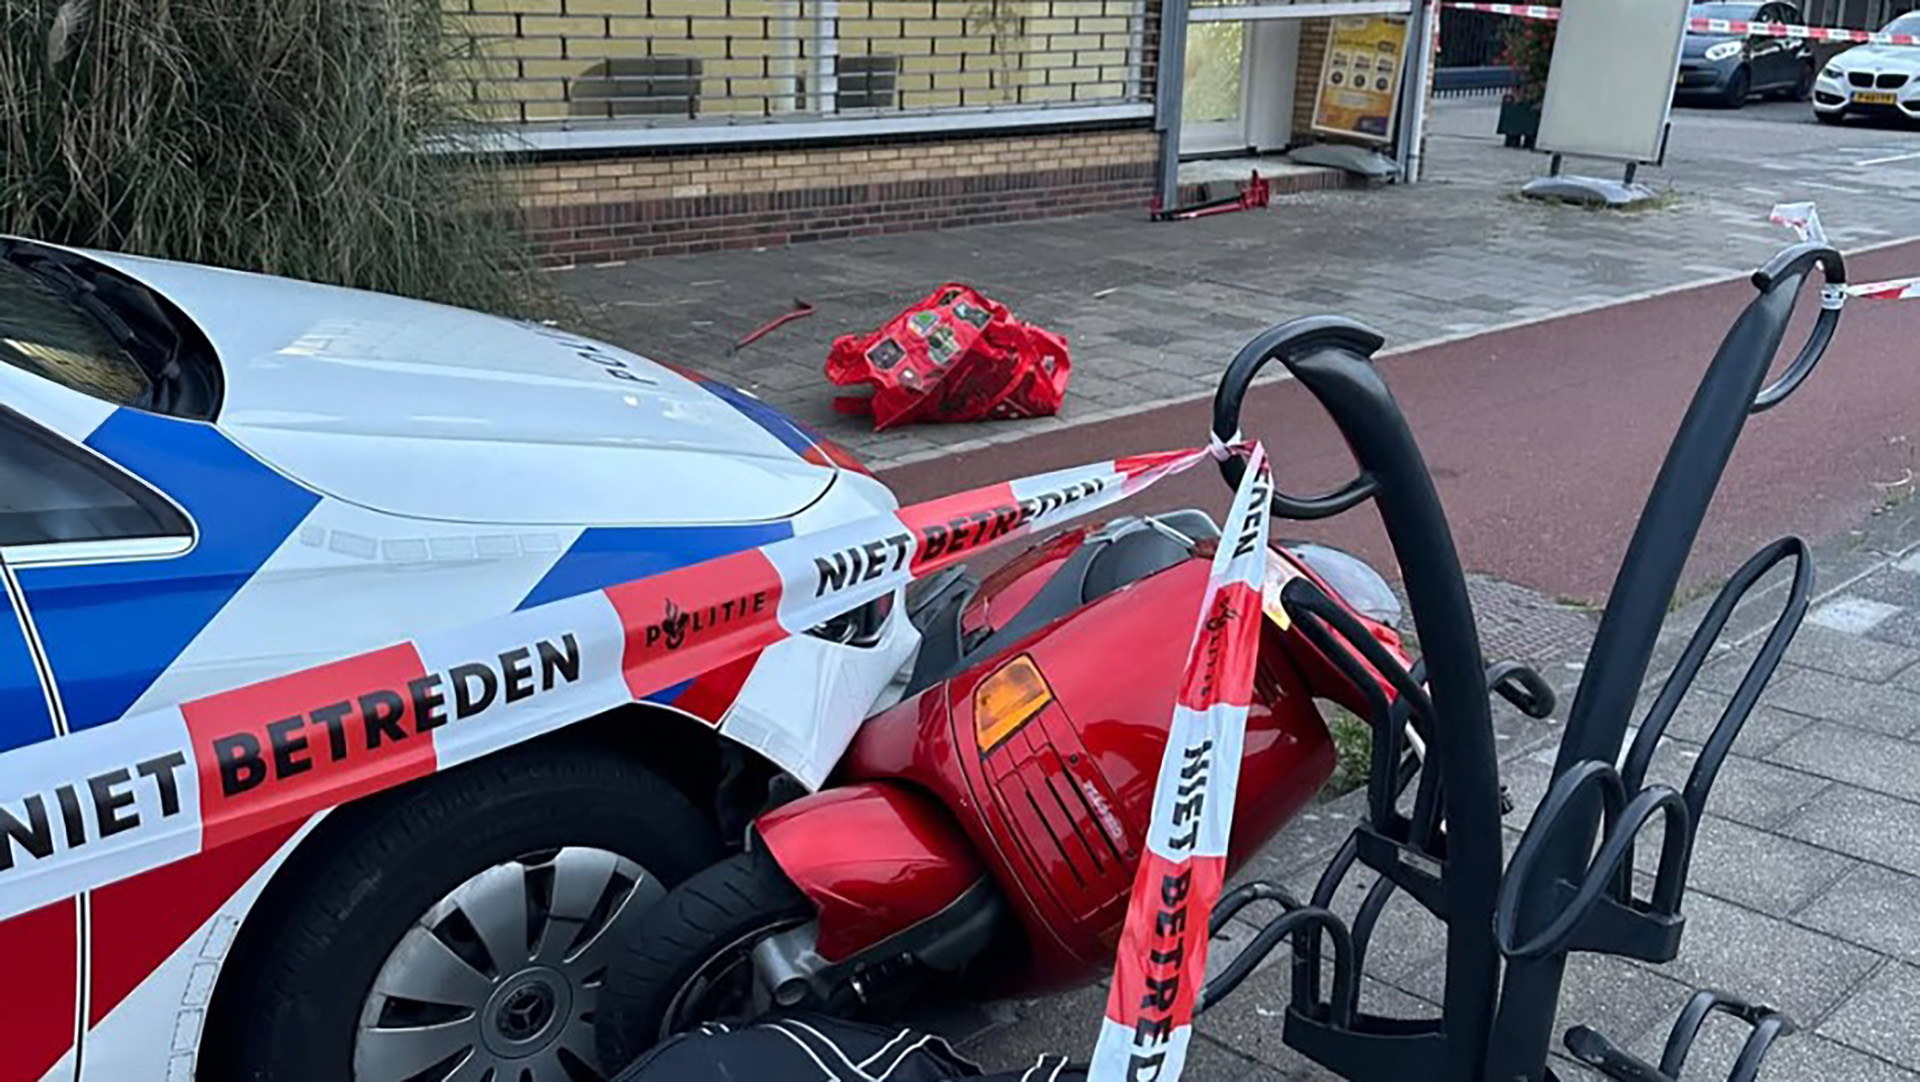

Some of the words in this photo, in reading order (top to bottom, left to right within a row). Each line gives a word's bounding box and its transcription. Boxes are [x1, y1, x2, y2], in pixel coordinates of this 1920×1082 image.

[814, 533, 911, 599] NIET
[922, 478, 1104, 561] BETREDEN
[0, 750, 187, 870] NIET
[212, 633, 580, 798] BETREDEN
[1168, 739, 1212, 852] NIET
